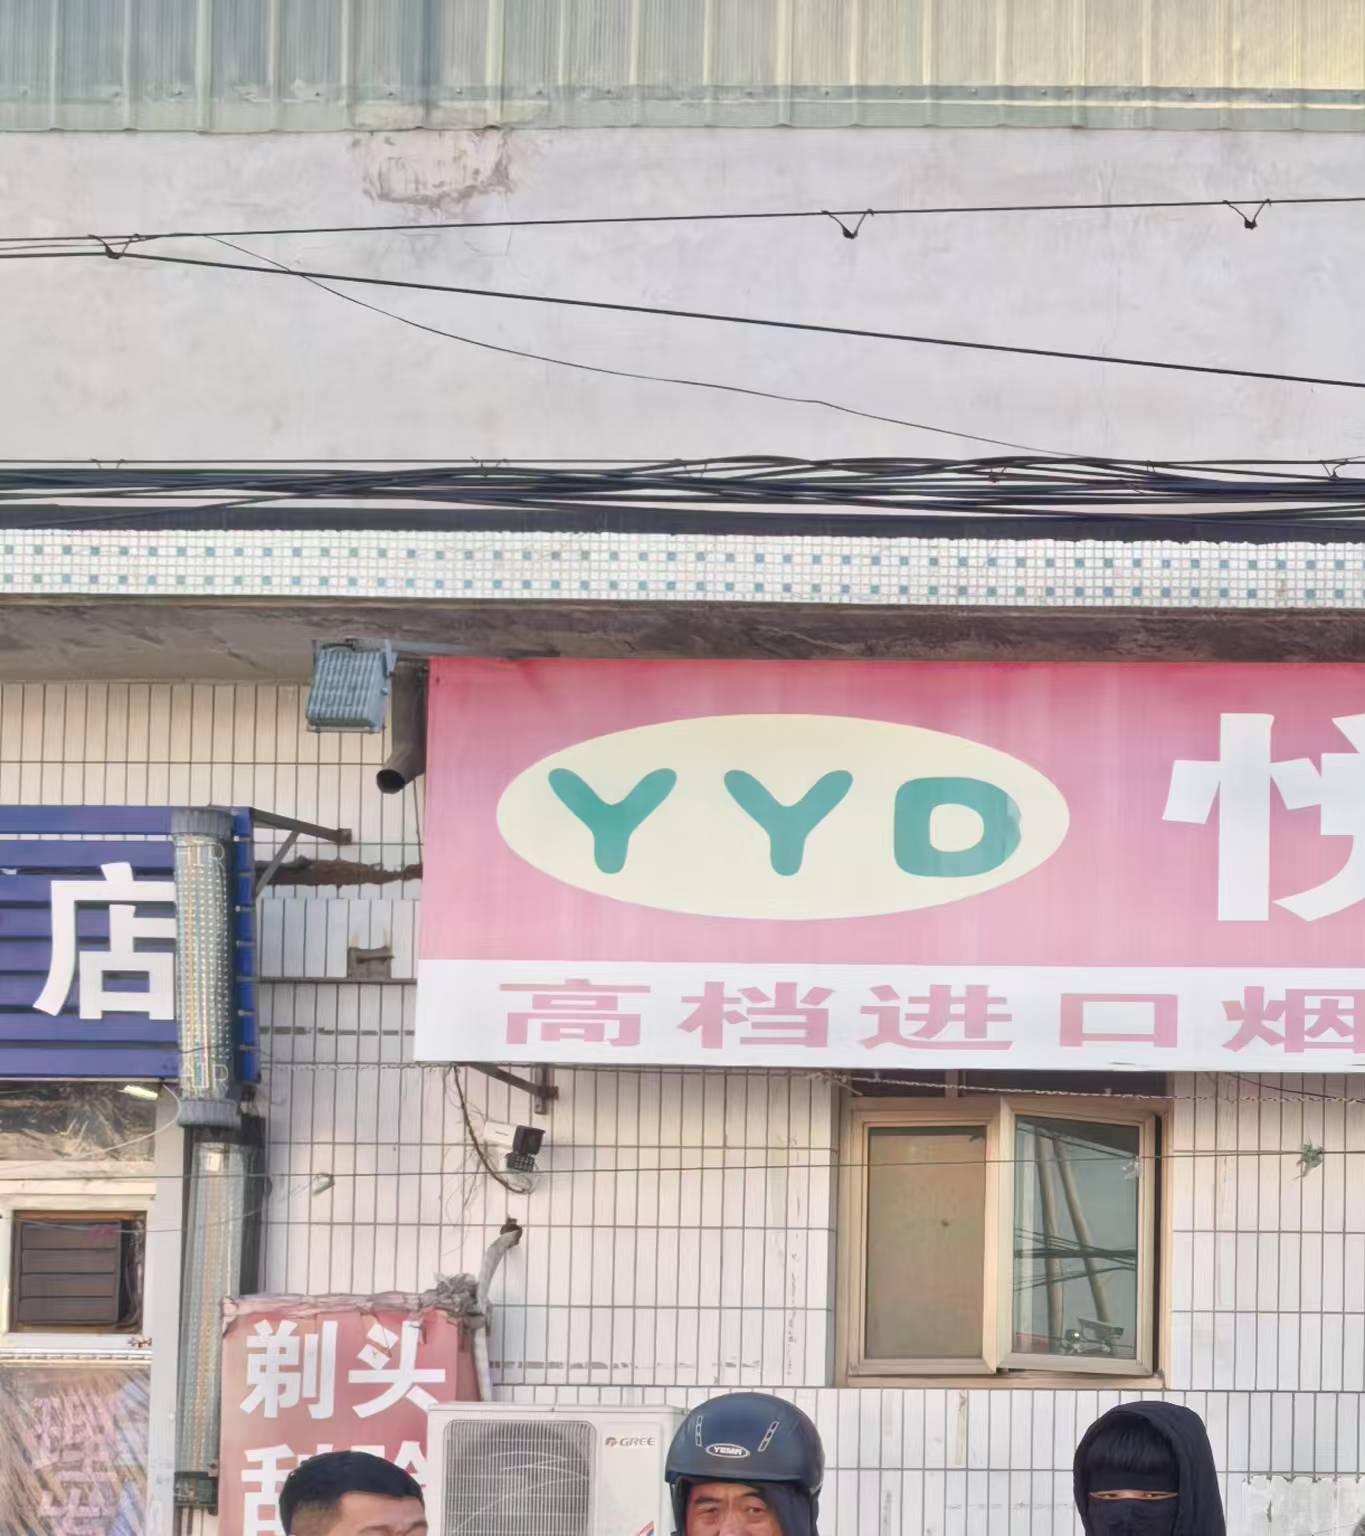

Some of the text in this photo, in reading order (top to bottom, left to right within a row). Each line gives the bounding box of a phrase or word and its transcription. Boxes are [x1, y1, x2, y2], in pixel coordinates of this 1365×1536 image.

[548, 766, 1022, 877] YYD
[33, 861, 177, 1021] 店
[239, 1318, 446, 1420] 剃头
[619, 1436, 656, 1447] GREE
